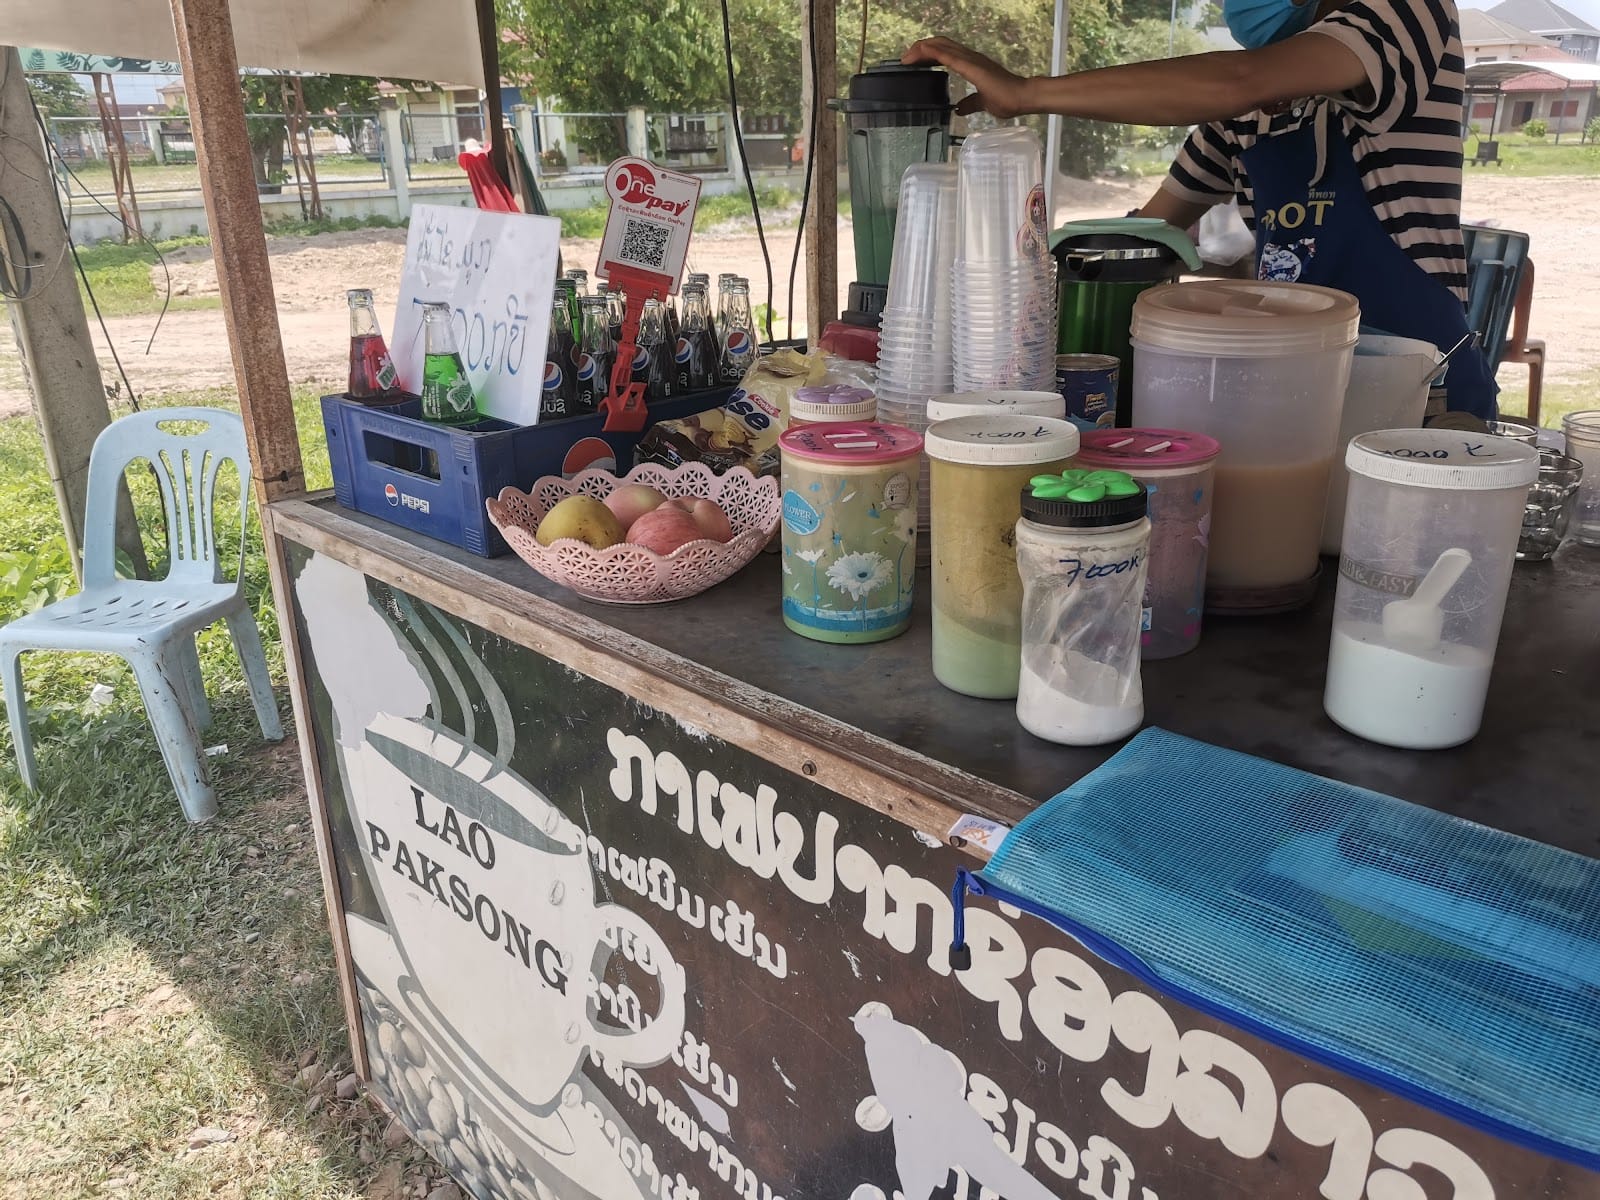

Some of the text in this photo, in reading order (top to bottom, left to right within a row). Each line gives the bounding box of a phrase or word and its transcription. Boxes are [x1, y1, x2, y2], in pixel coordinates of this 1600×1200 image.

[645, 196, 690, 217] pay
[720, 366, 747, 380] pep
[401, 493, 431, 515] PEPSI
[410, 785, 496, 870] LAO
[365, 820, 569, 997] PAKSONG
